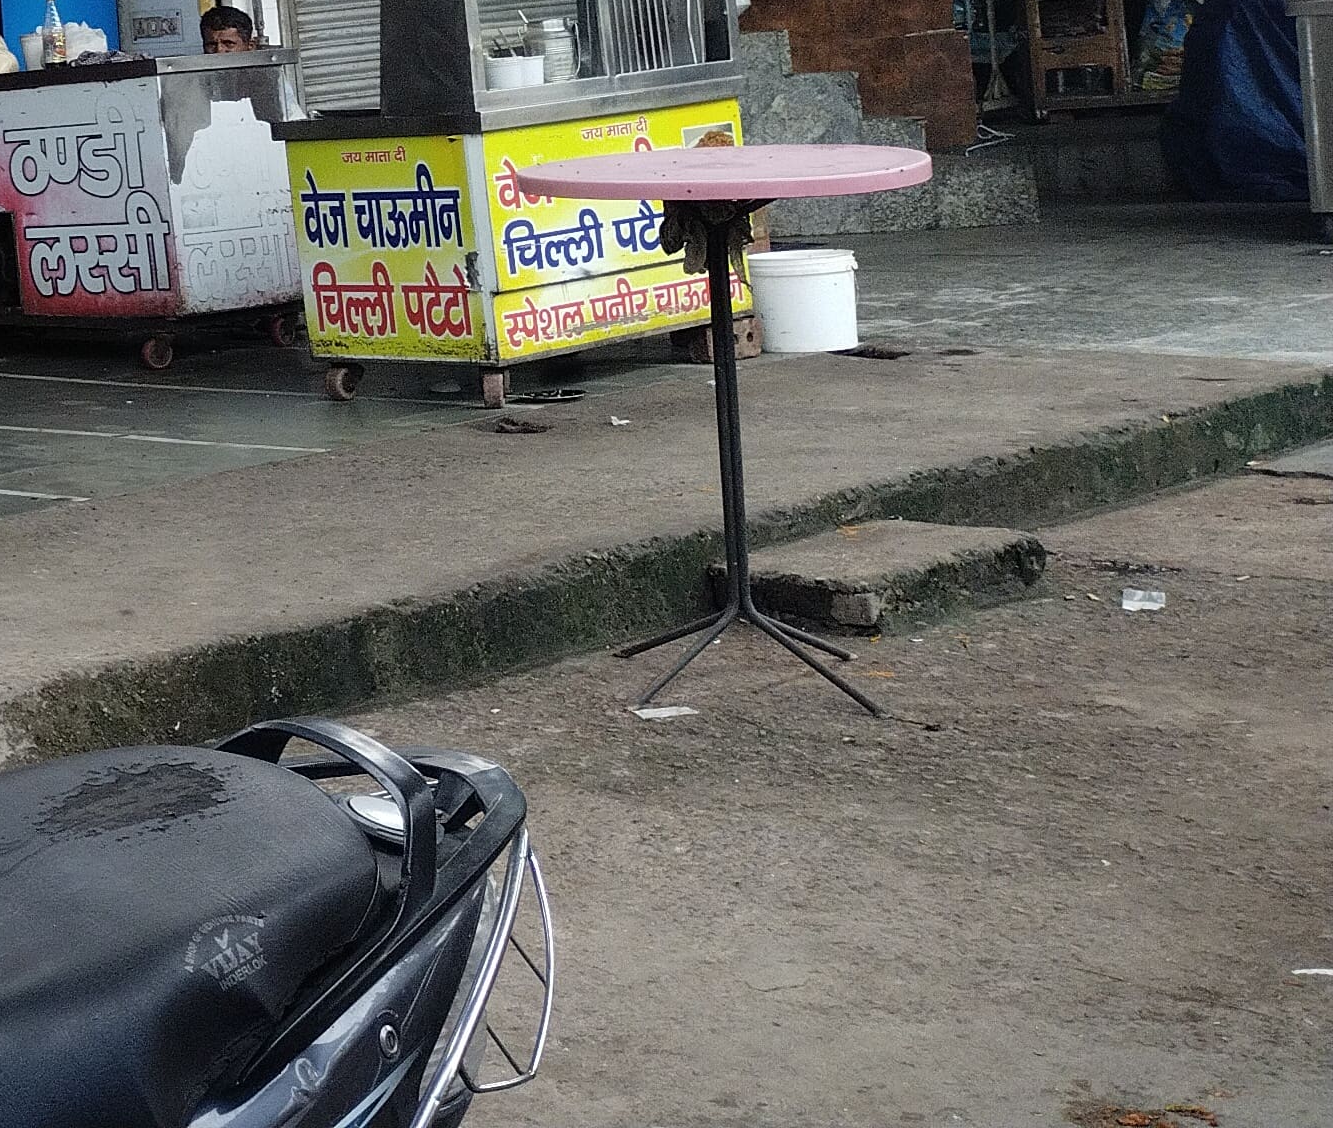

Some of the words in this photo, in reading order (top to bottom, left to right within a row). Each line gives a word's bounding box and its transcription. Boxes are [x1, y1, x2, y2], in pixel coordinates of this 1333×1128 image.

[341, 152, 362, 164] जय
[364, 150, 391, 163] माता
[393, 146, 406, 162] दी
[582, 126, 604, 141] जय
[606, 122, 633, 138] माता
[634, 116, 648, 133] दी
[300, 169, 349, 248] वेज
[352, 163, 464, 248] चाऊमीन
[25, 190, 172, 297] लस्सी
[503, 208, 604, 274] चिल्ली
[312, 261, 397, 337] चिल्ली
[503, 296, 585, 349] स्पेशल
[200, 932, 264, 979] VIJAY
[219, 955, 268, 991] INDERLOK
